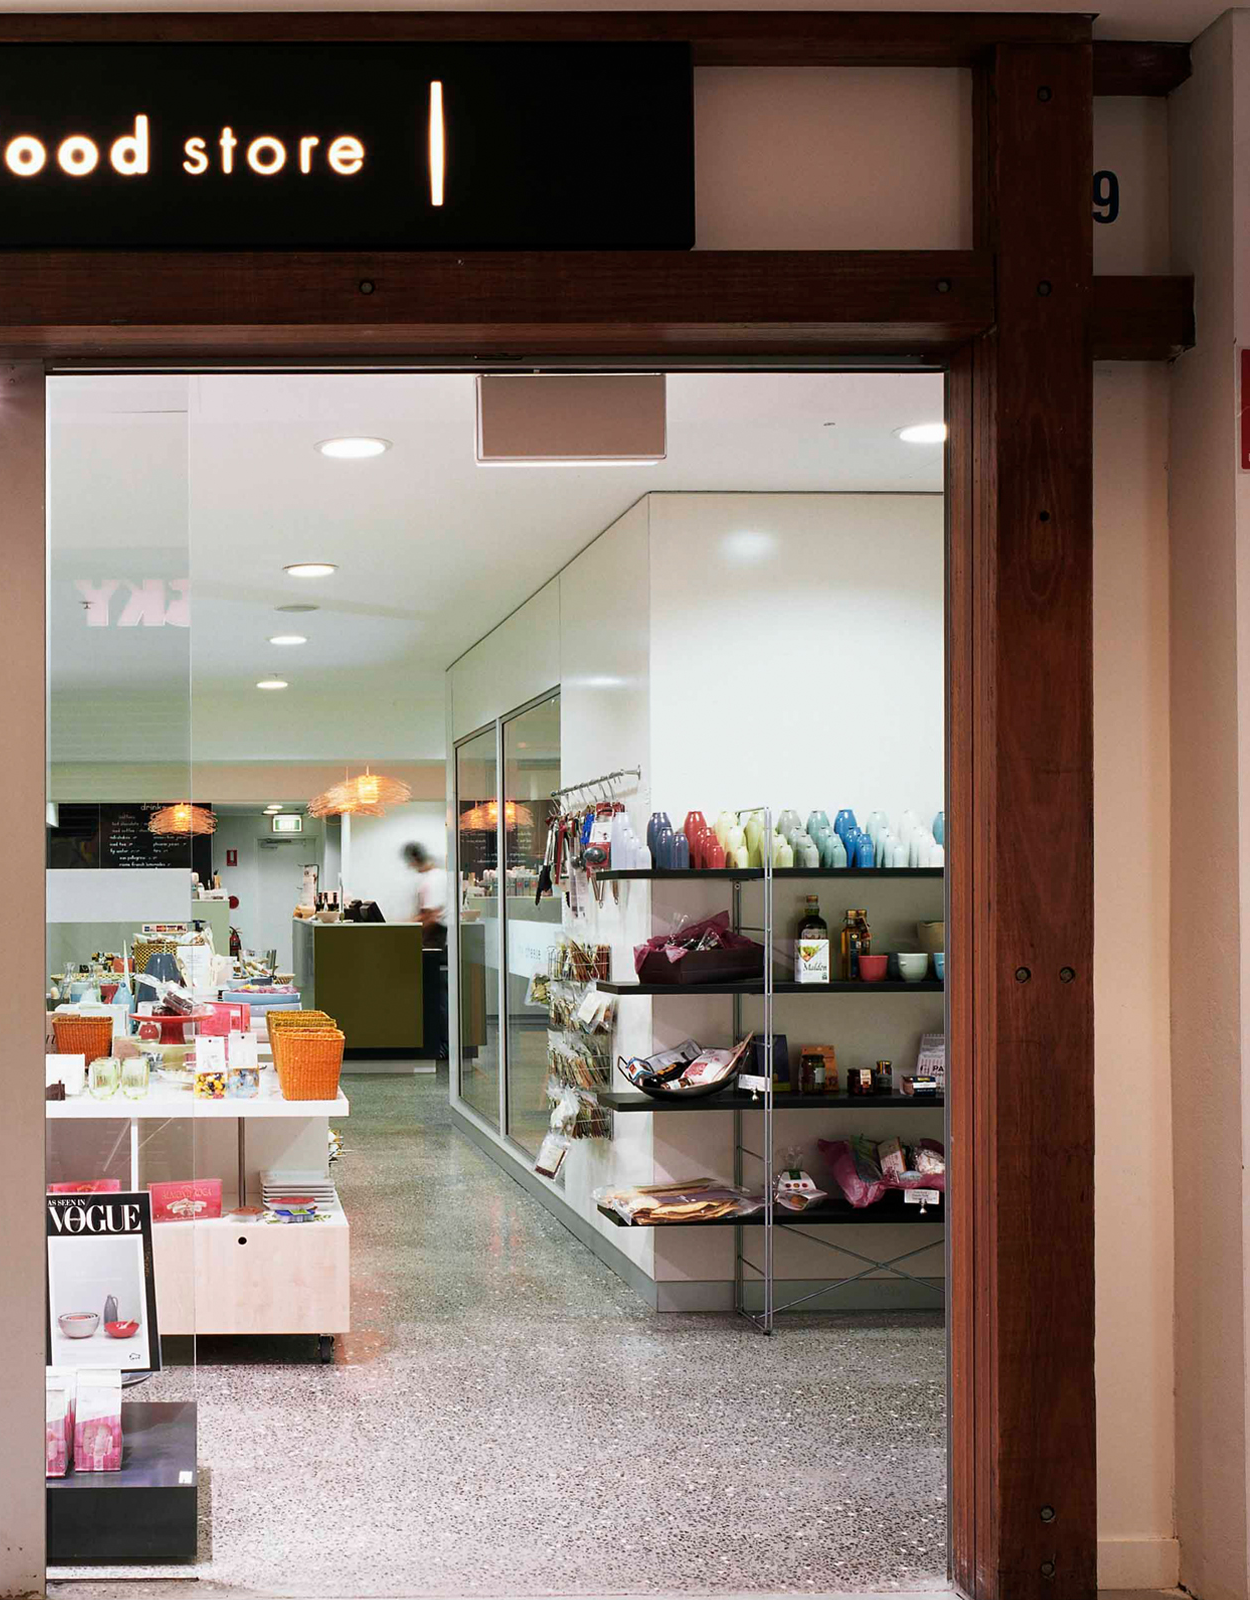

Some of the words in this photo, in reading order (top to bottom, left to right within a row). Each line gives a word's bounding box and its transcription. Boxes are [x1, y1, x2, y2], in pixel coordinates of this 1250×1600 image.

[183, 127, 364, 175] store
[1093, 170, 1119, 224] 9
[49, 1204, 142, 1233] VOGUE
[76, 1198, 86, 1206] IN
